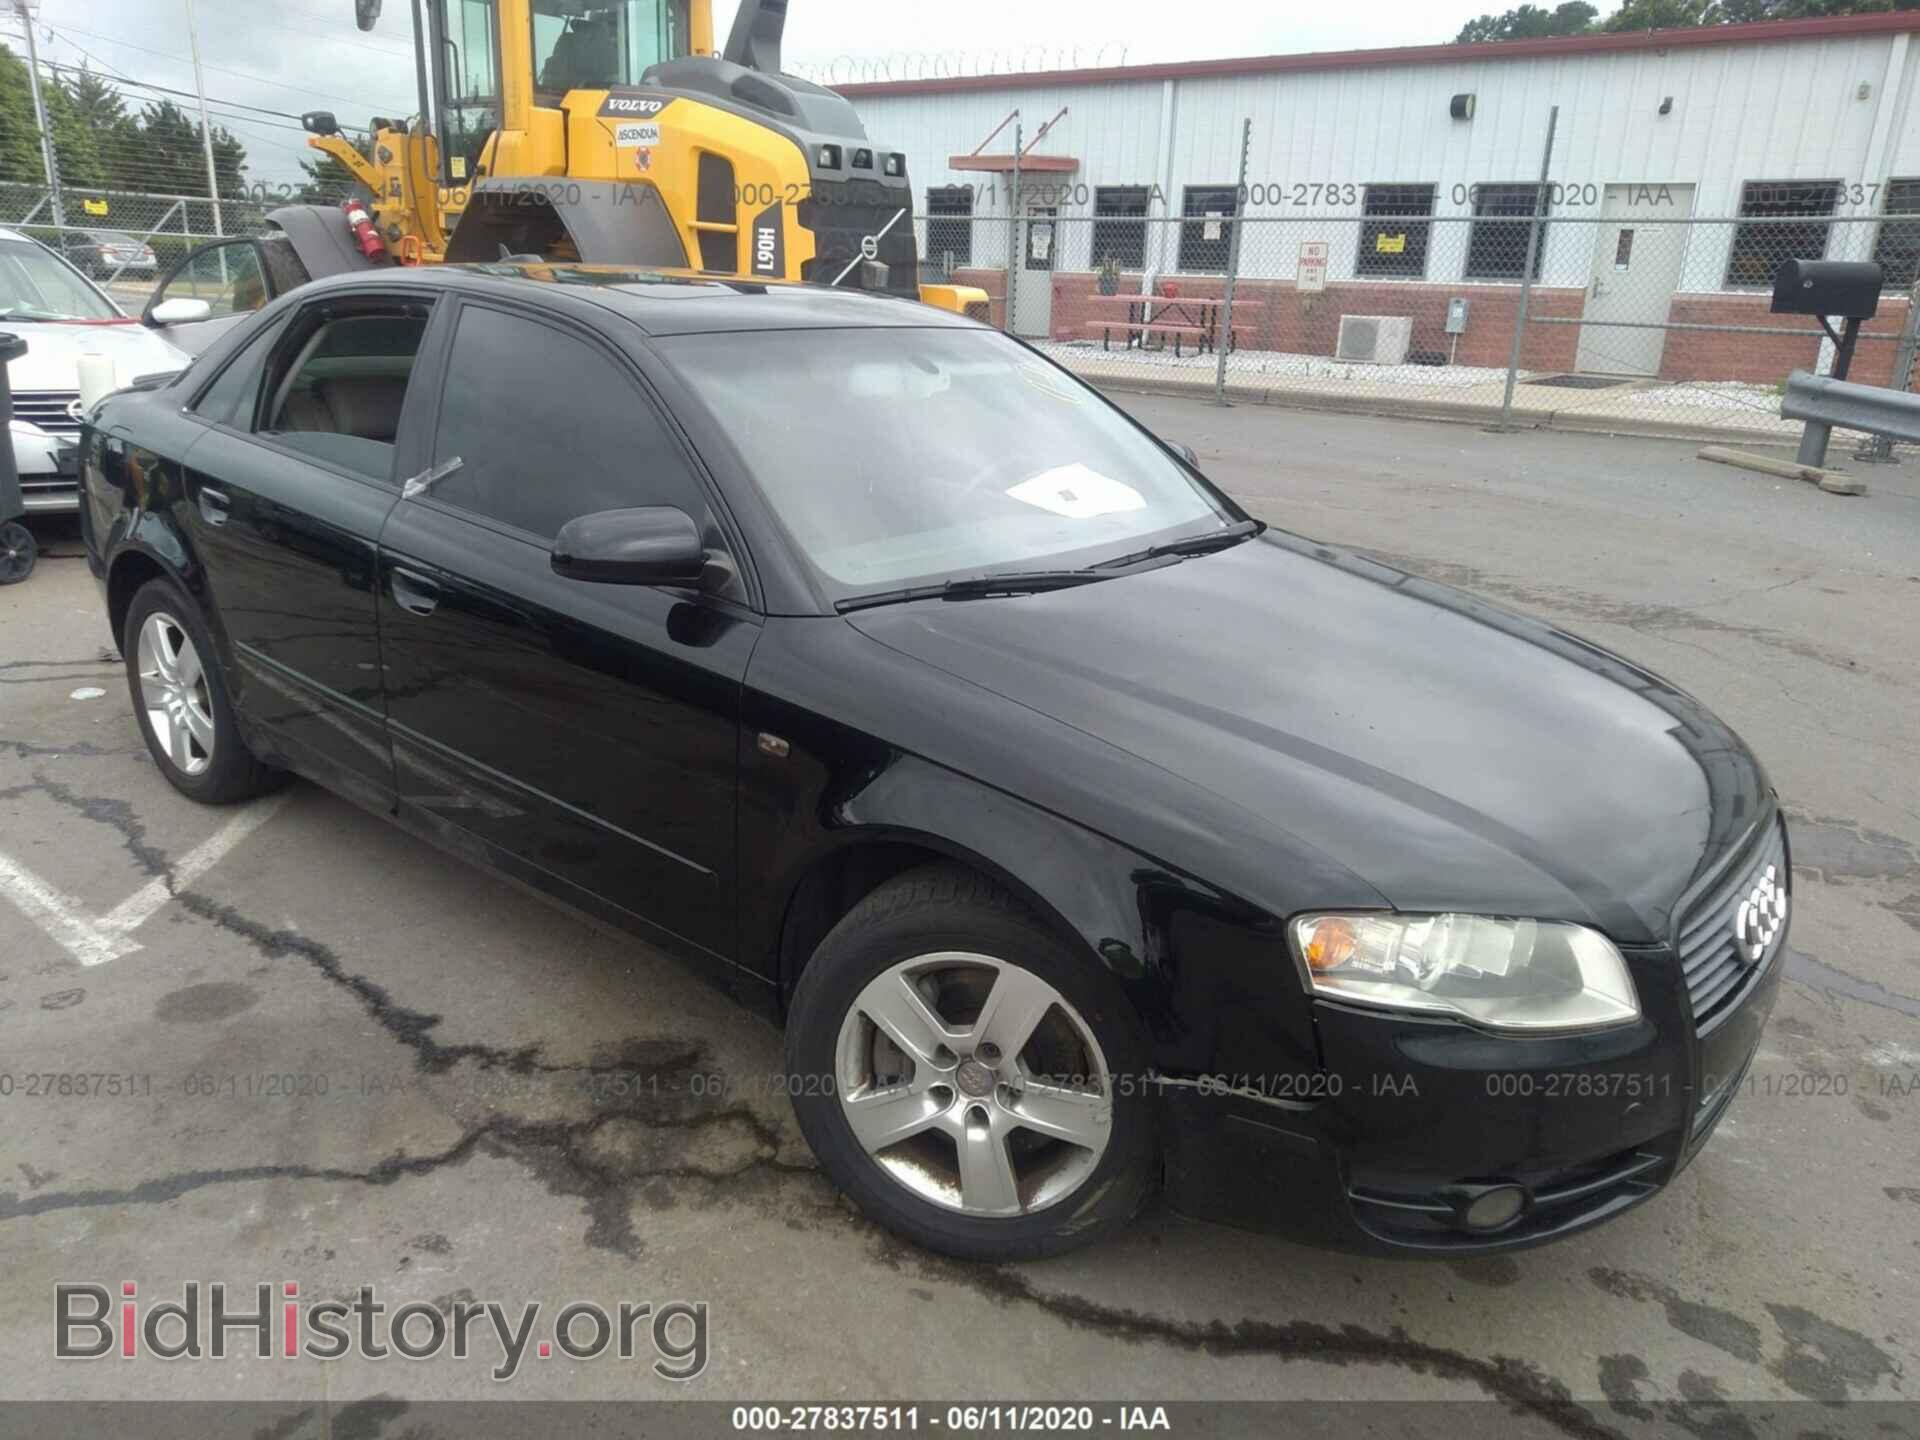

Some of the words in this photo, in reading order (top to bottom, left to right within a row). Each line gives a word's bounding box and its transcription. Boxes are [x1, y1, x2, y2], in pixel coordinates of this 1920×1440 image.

[608, 98, 663, 113] VOLVO
[618, 127, 658, 141] ASCENDUM
[756, 227, 775, 271] L90H
[1308, 246, 1320, 256] NO
